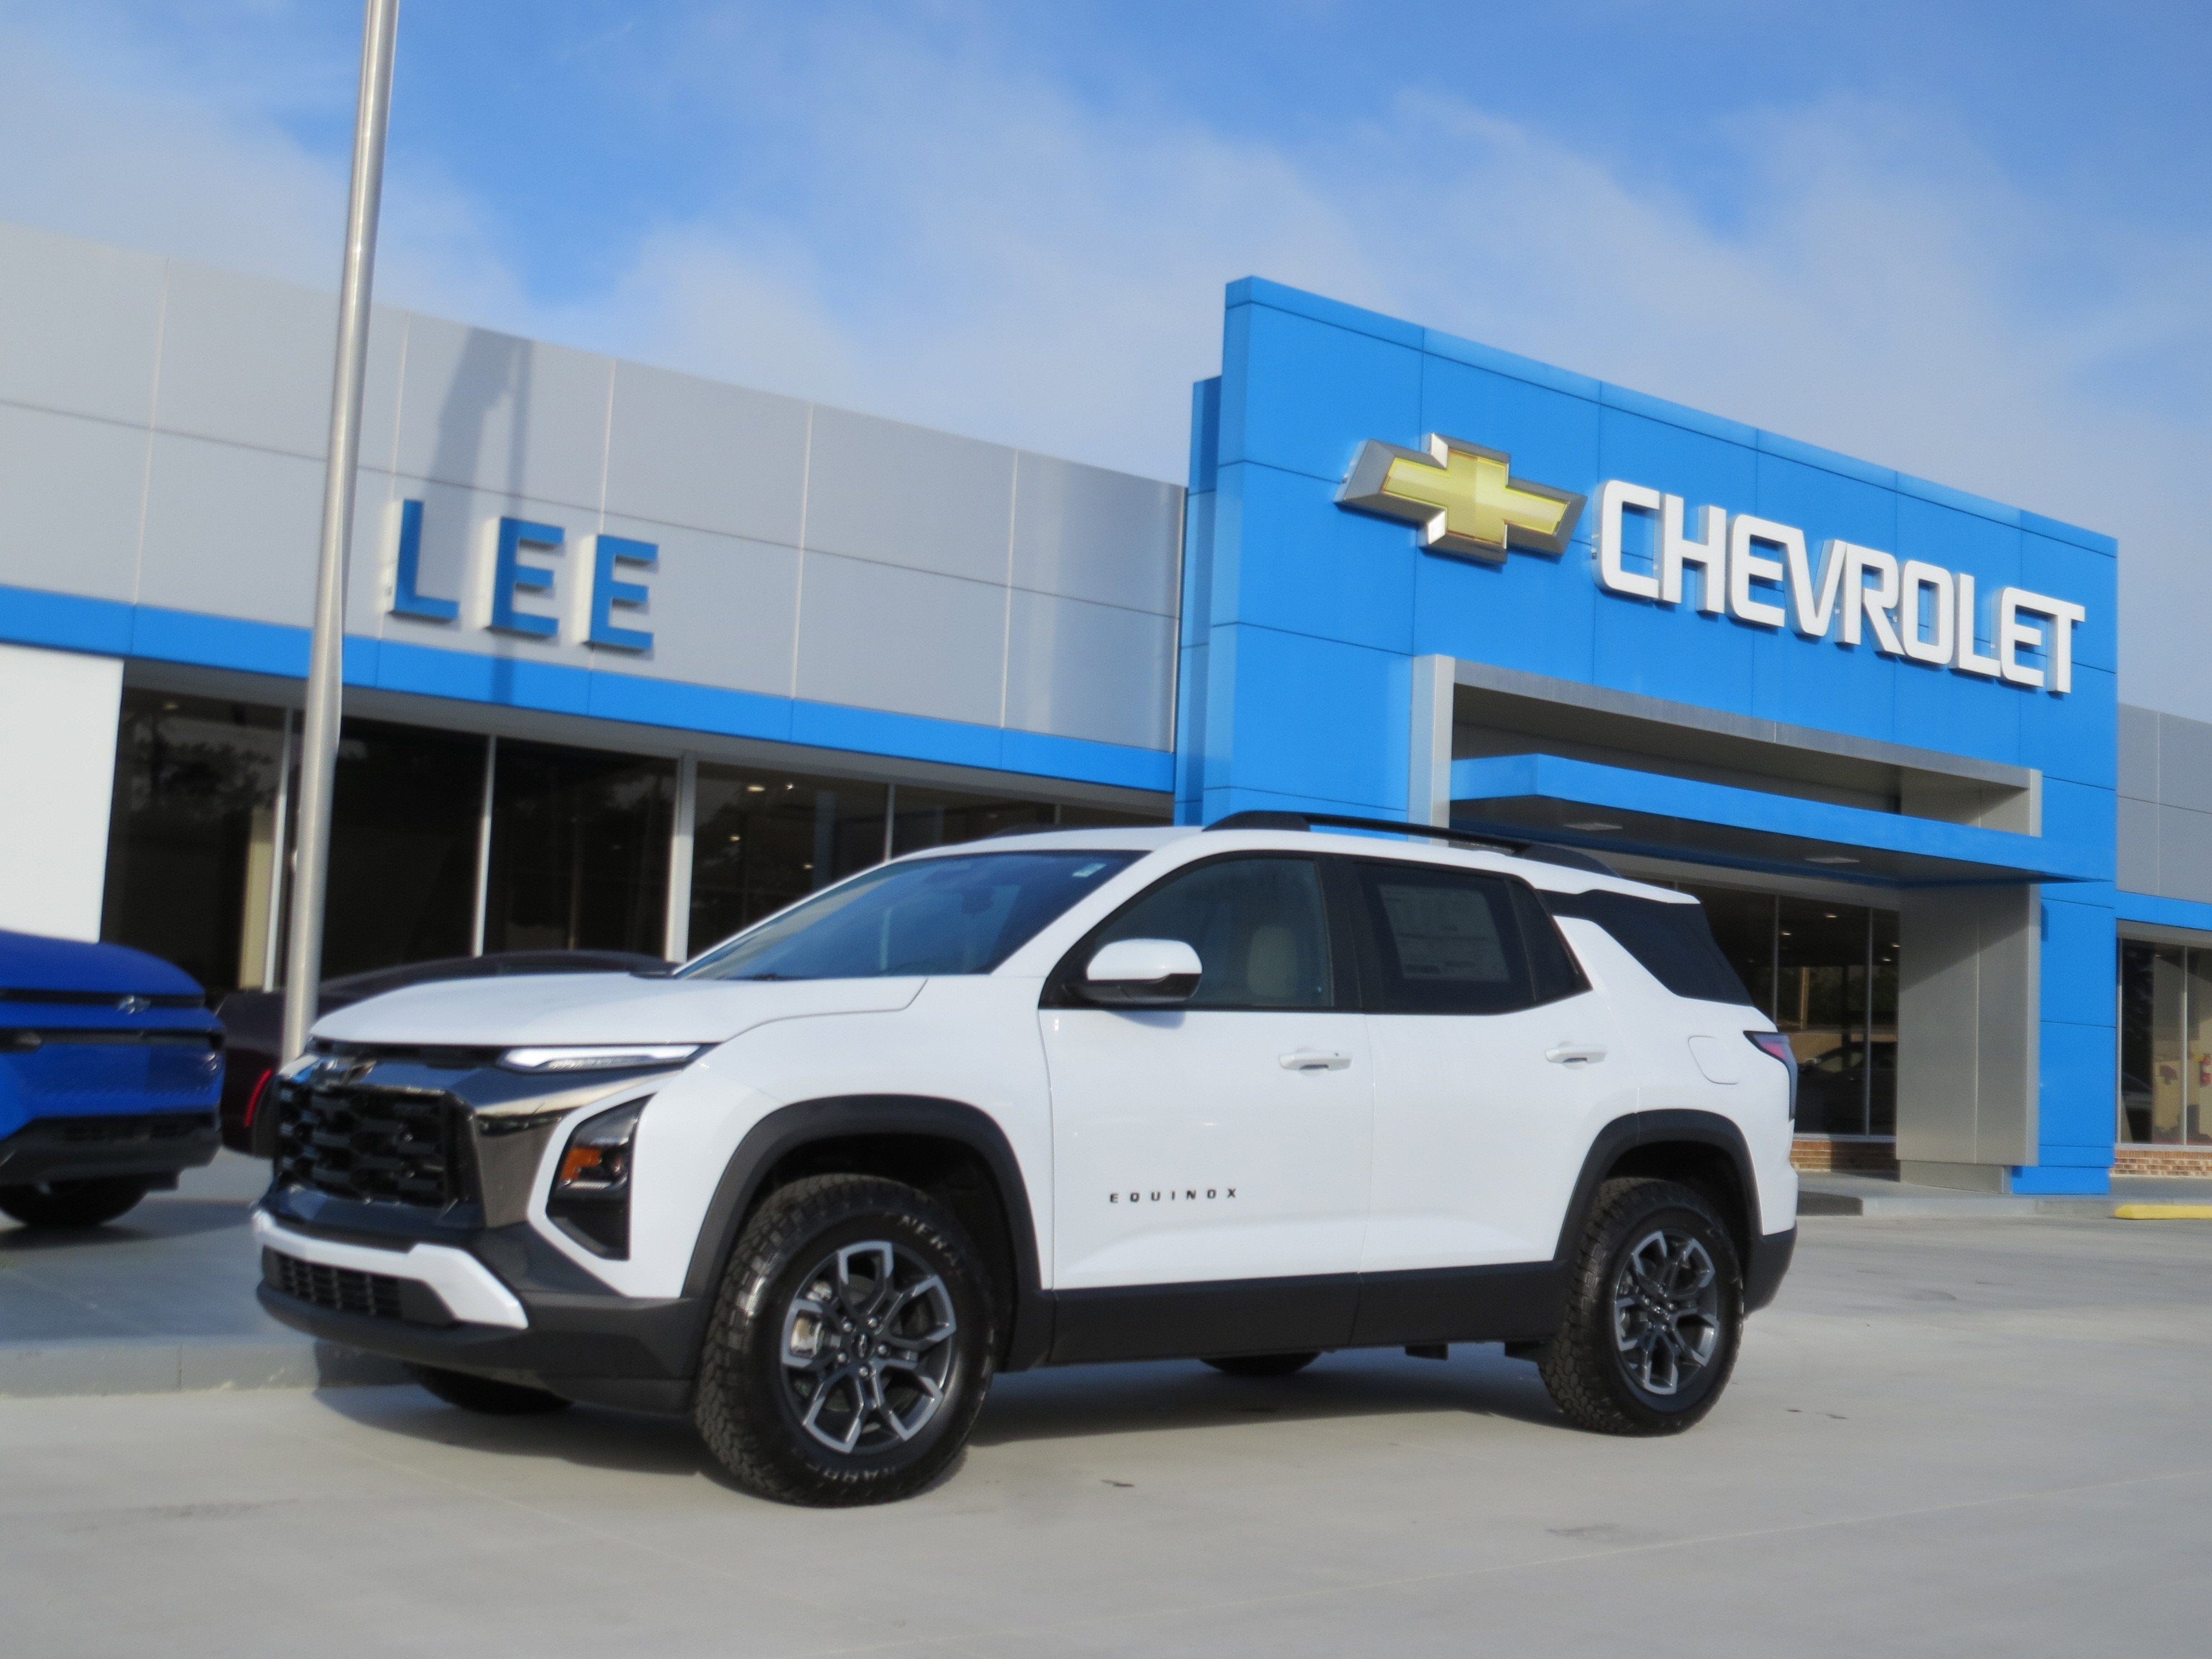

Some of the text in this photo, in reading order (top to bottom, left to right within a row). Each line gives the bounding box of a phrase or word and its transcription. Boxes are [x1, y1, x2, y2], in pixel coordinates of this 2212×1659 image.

[387, 498, 659, 650] LEE
[1595, 479, 2085, 693] CHEVROLET
[1109, 1188, 1237, 1203] EQUINOX
